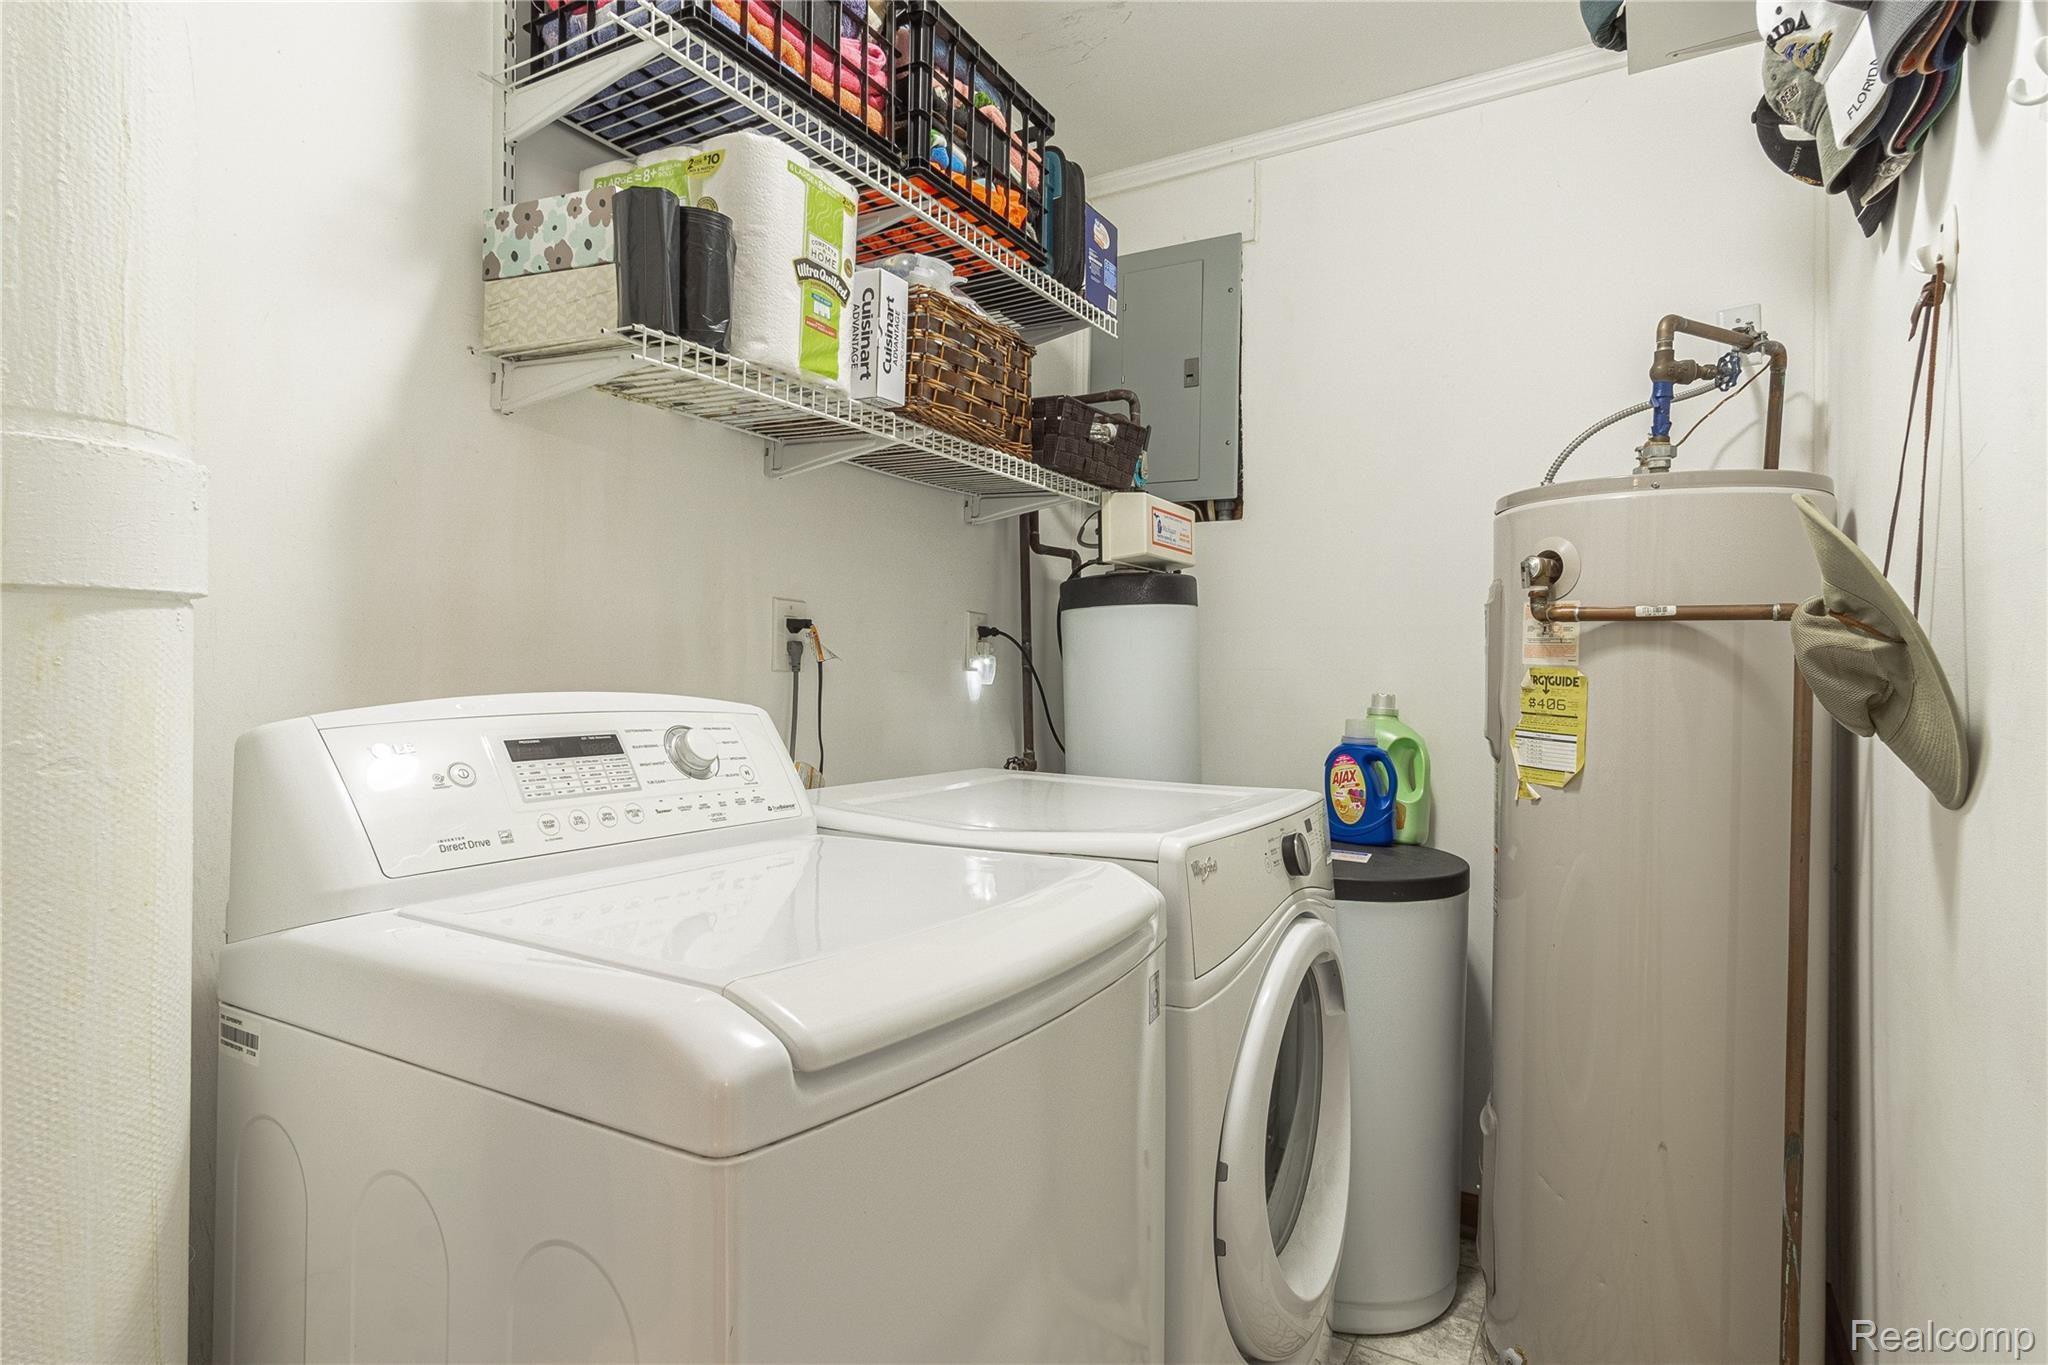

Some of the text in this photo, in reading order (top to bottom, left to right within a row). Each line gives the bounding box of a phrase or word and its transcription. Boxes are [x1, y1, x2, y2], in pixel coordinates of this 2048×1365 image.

[688, 159, 694, 169] 2
[703, 153, 720, 165] $10
[811, 250, 837, 269] HOME
[851, 303, 860, 369] ADVANTAGE
[860, 287, 875, 381] Cuisinart
[882, 295, 895, 374] Cuisinart
[893, 310, 901, 367] ADVANTAGE
[1530, 674, 1580, 692] RGYGUIDE
[1528, 696, 1567, 711] $406
[1332, 770, 1357, 786] AJAX
[439, 839, 491, 853] Direct Drive
